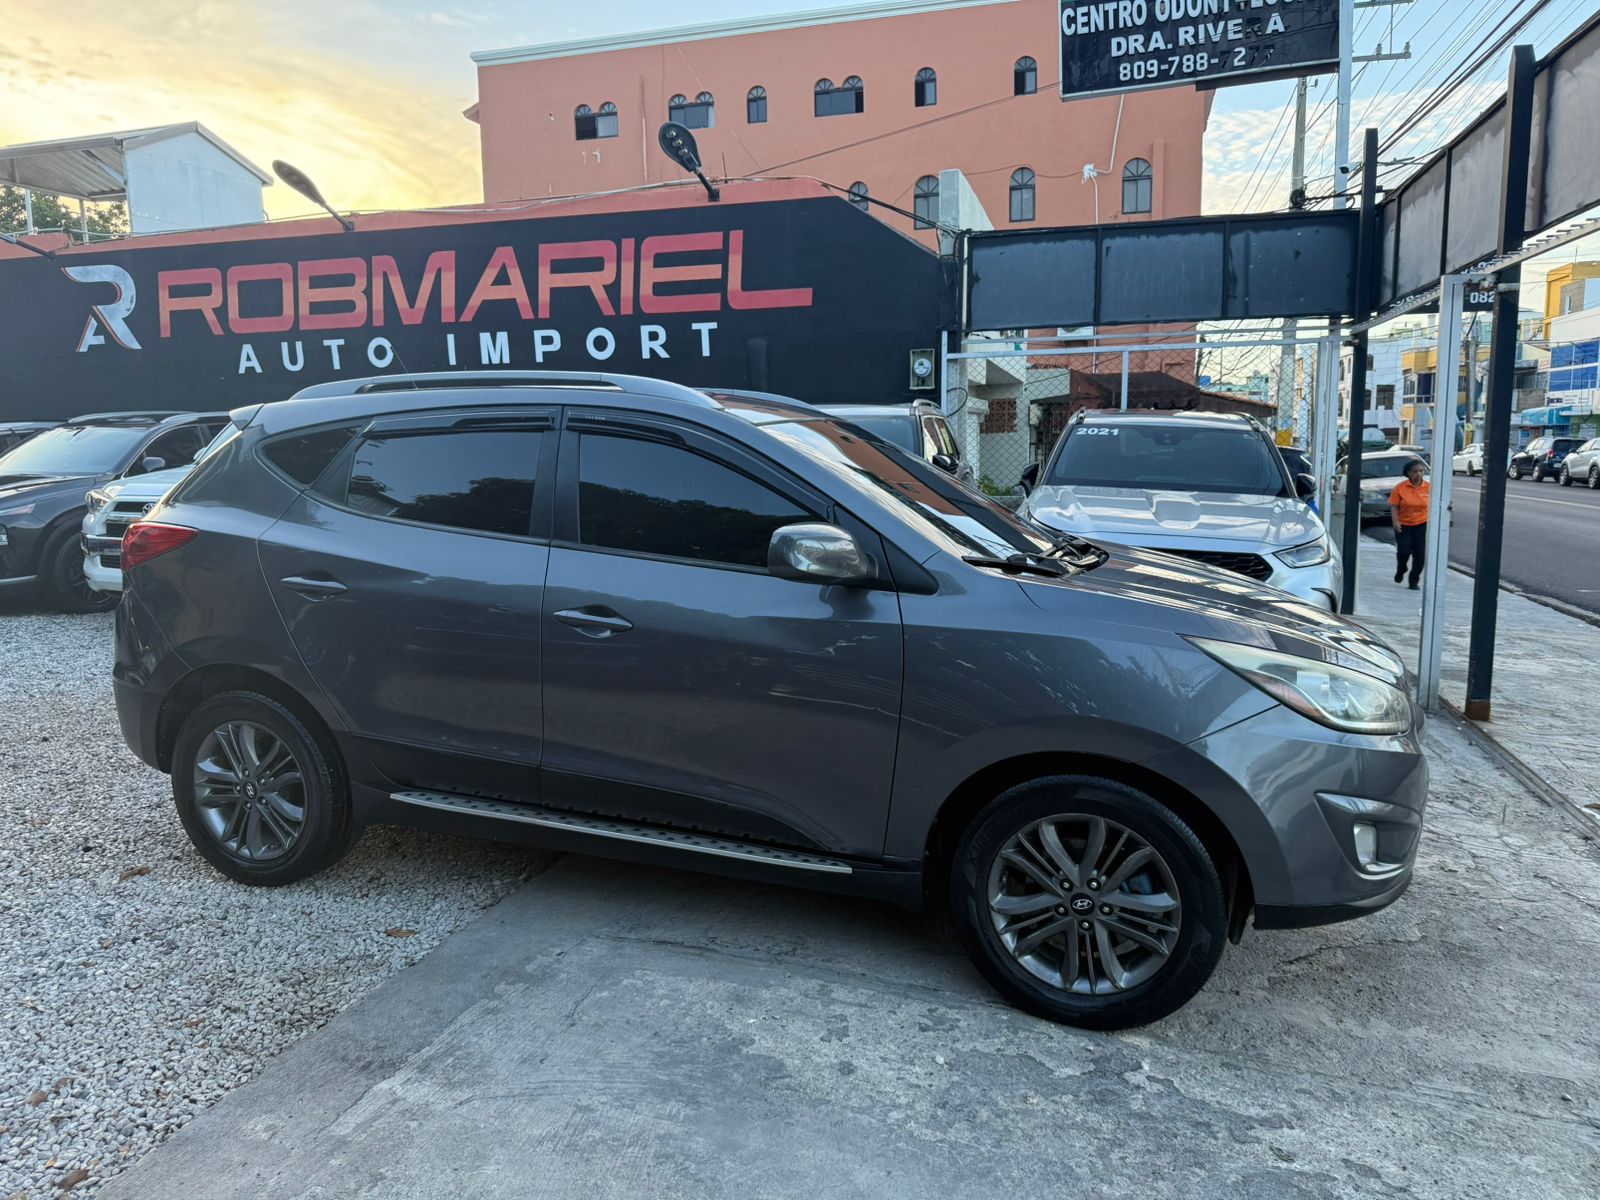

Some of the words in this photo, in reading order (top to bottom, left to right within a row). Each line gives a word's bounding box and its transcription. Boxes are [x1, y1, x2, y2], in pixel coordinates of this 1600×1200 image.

[1061, 0, 1147, 36] CENTRO
[1111, 33, 1173, 57] DRA.
[157, 229, 813, 338] ROBMARIEL
[238, 336, 395, 375] AUTO
[446, 321, 718, 366] IMPORT
[1075, 427, 1119, 436] 2021
